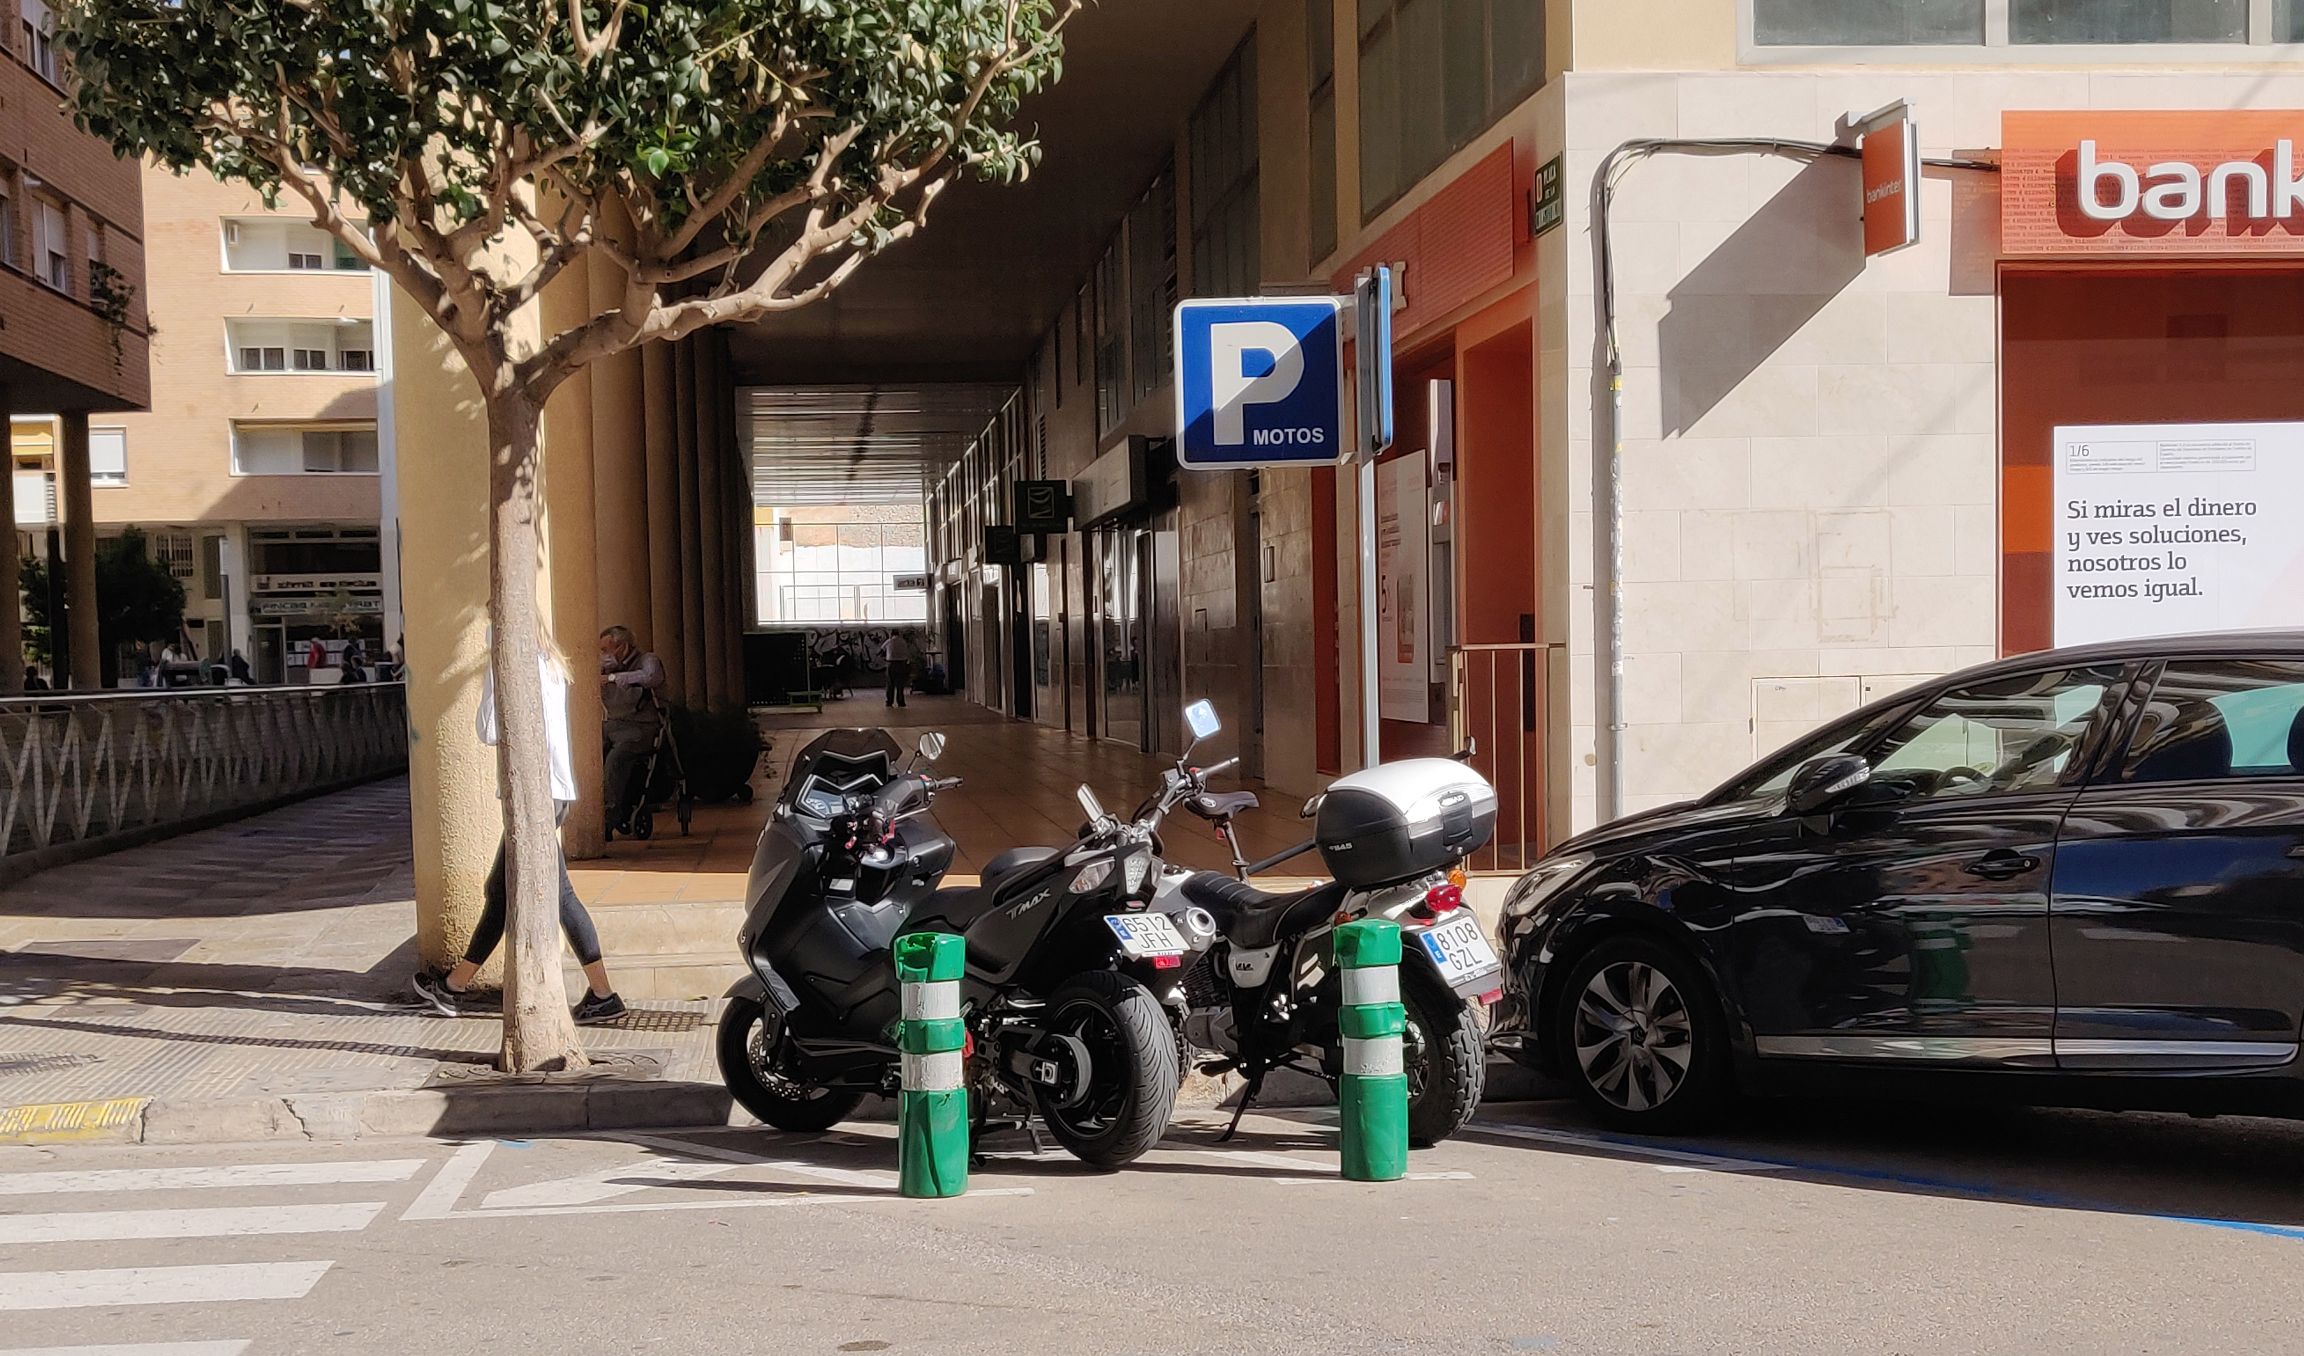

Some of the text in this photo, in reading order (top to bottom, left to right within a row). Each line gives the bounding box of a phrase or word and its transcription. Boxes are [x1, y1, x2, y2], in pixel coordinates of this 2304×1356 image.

[1866, 179, 1902, 203] bankinter
[1210, 321, 1305, 446] P
[1253, 427, 1325, 446] MOTOS
[2069, 444, 2090, 458] 1/6
[2067, 498, 2257, 519] Si miras el dinero
[2067, 525, 2247, 551] y ves soluciones,
[2067, 551, 2187, 573] nosotros lo
[2067, 577, 2204, 602] vemos igual.
[1006, 887, 1052, 920] TMAX
[1122, 916, 1171, 933] 6512
[1437, 922, 1478, 951] 8108
[1140, 932, 1173, 949] JFH
[1449, 946, 1482, 970] GZL
